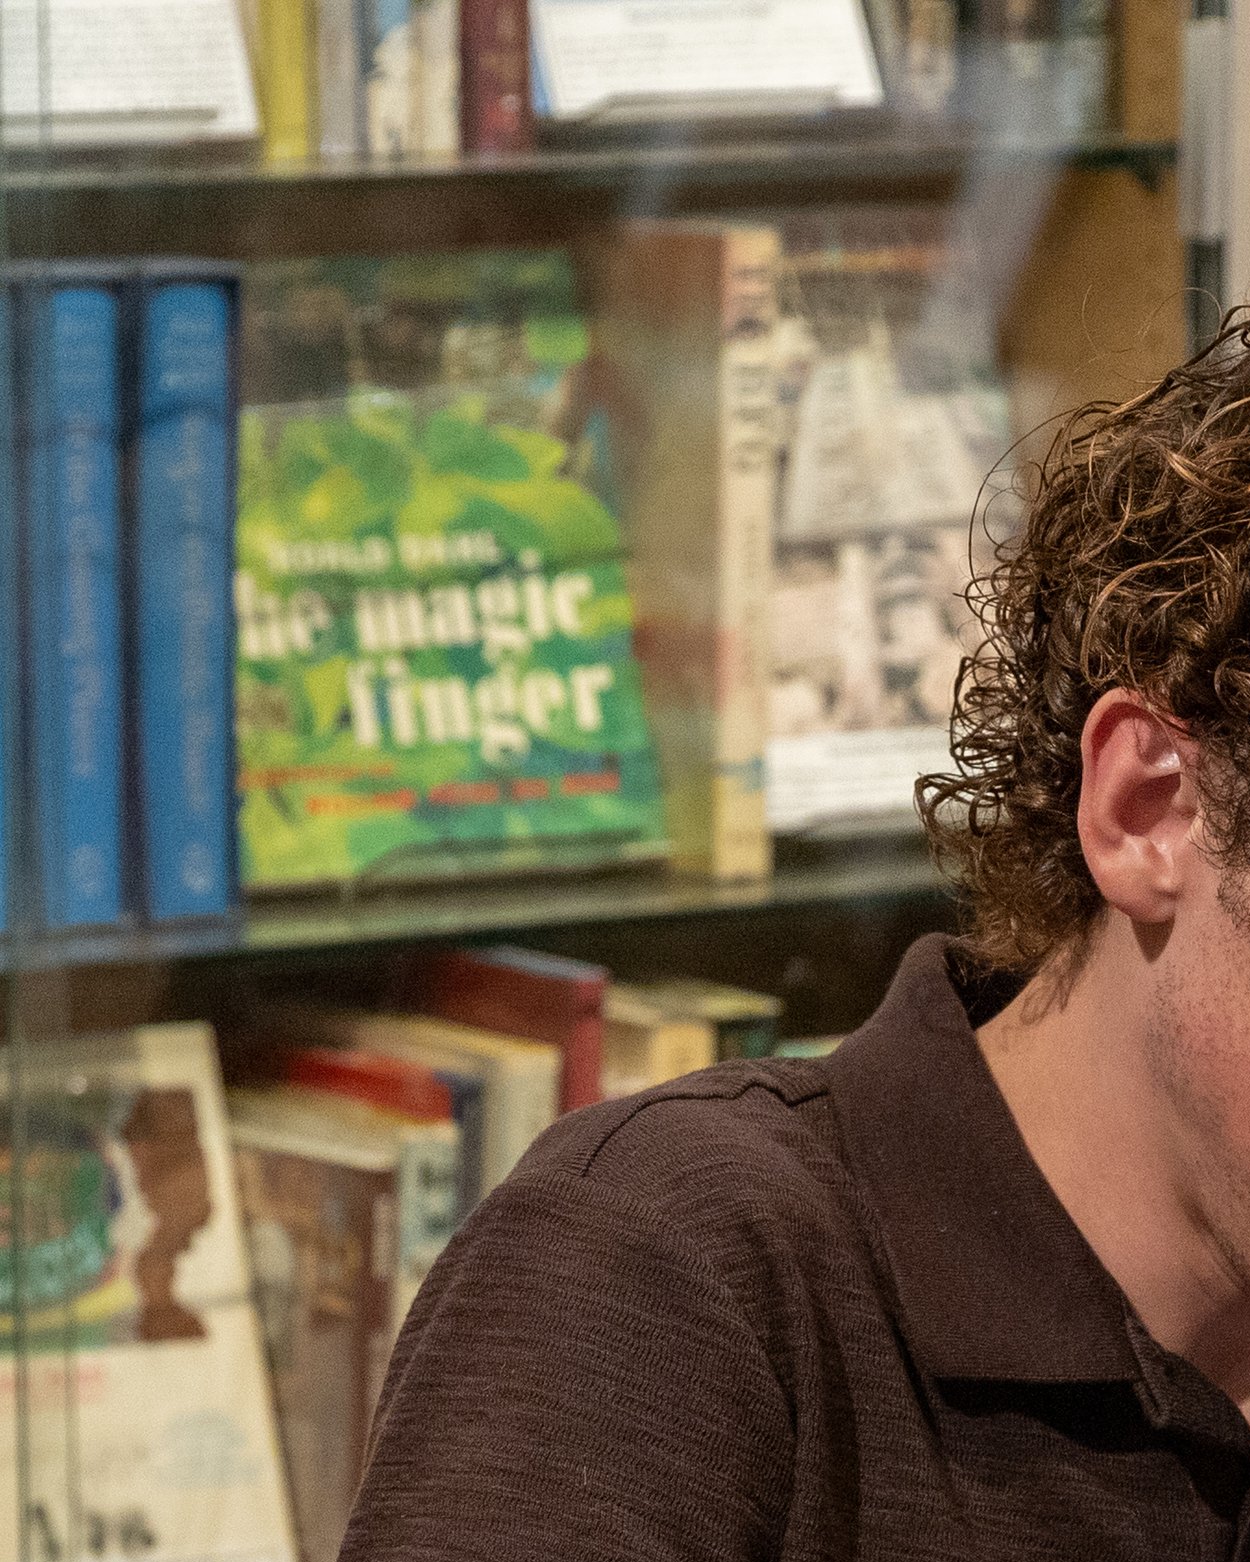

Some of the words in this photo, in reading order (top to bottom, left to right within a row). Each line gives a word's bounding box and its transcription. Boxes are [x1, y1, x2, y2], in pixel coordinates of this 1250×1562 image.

[235, 568, 332, 661] he
[355, 547, 595, 666] magic
[347, 656, 615, 768] finger
